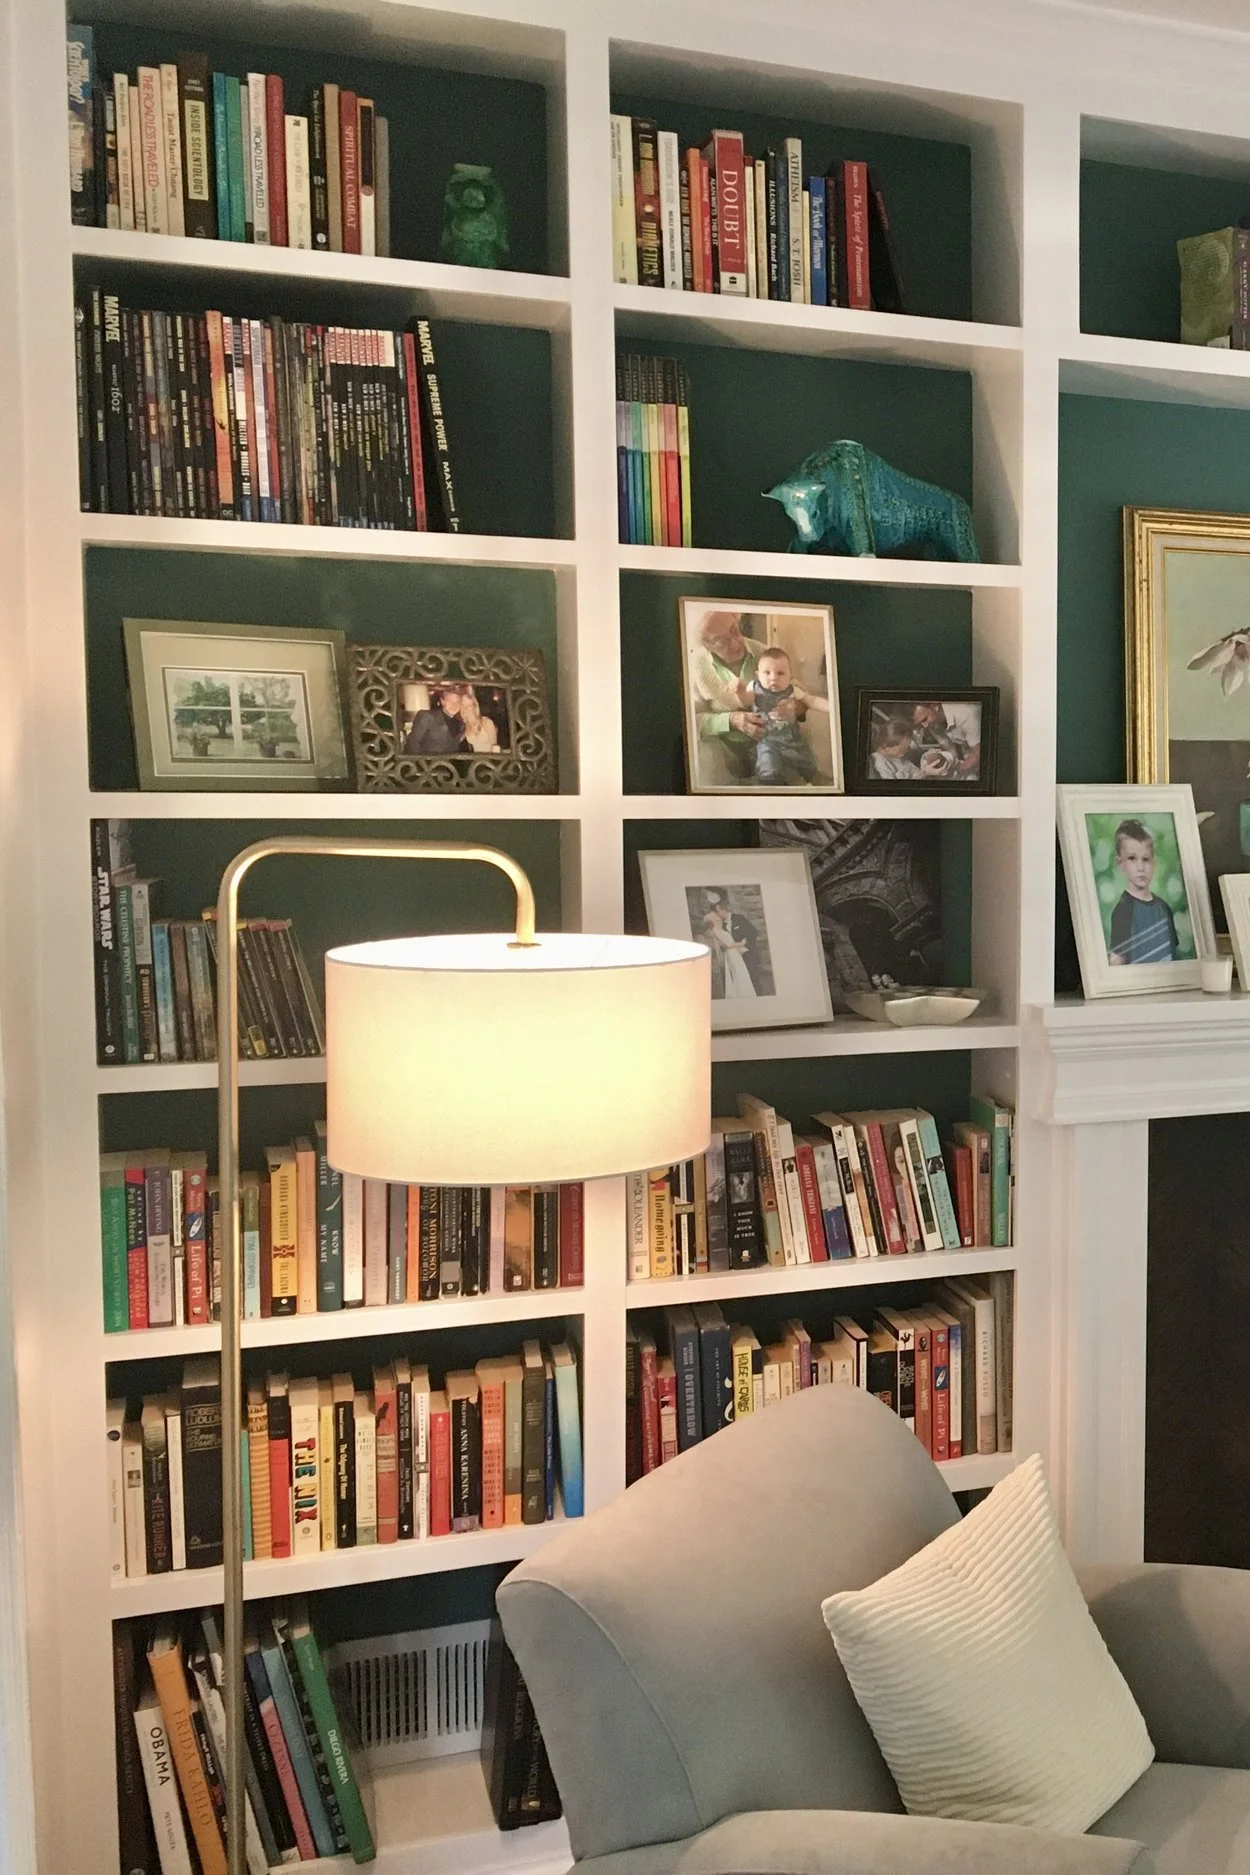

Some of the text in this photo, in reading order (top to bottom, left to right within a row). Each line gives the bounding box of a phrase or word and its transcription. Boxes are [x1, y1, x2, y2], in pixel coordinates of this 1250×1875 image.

[143, 75, 160, 187] THE ROAD LESS TRAVELED
[190, 105, 204, 196] INSIDE SCIENTOLOGY
[254, 132, 264, 208] ROAD LESS TRAVELED
[344, 125, 357, 229] SPIRITUAL COMBAT
[791, 152, 800, 203] ATHEISM
[721, 170, 739, 249] DOUBT
[851, 210, 863, 233] Spirit
[853, 194, 863, 209] The
[641, 222, 659, 275] DIANETICS
[852, 235, 864, 244] of
[104, 296, 120, 343] MARVEL
[417, 320, 434, 365] MARVEL
[110, 387, 123, 414] 1602
[427, 373, 448, 451] SUPREME POWER
[442, 462, 453, 489] MAX
[97, 867, 113, 950] STAR WARS
[136, 918, 144, 946] GIBSON
[119, 890, 132, 984] THE CELESTINE PROPHECY
[127, 1188, 137, 1245] Pat McNees
[154, 1181, 163, 1233] JOHN IRVING
[320, 1224, 327, 1238] MY
[634, 1195, 644, 1244] OLEANDER
[655, 1194, 668, 1253] Homegoing
[331, 1230, 339, 1256] KNOW
[429, 1187, 437, 1279] TONI MORRISON
[190, 1245, 203, 1299] Life of Pi
[736, 1353, 749, 1378] HOUSE
[684, 1373, 696, 1437] OVERTHROW
[737, 1386, 750, 1413] CARDS
[937, 1392, 946, 1439] Life of Pi
[338, 1454, 347, 1474] Odyssey
[340, 1443, 348, 1453] The
[460, 1428, 468, 1453] ANNA
[294, 1438, 318, 1524] THE NIX
[460, 1454, 469, 1500] KARENINA
[153, 1521, 167, 1559] RUNNER
[150, 1727, 171, 1786] OBAMA
[172, 1708, 212, 1827] FRIDA KAHLO
[328, 1728, 349, 1785] DIEGO RIVERA
